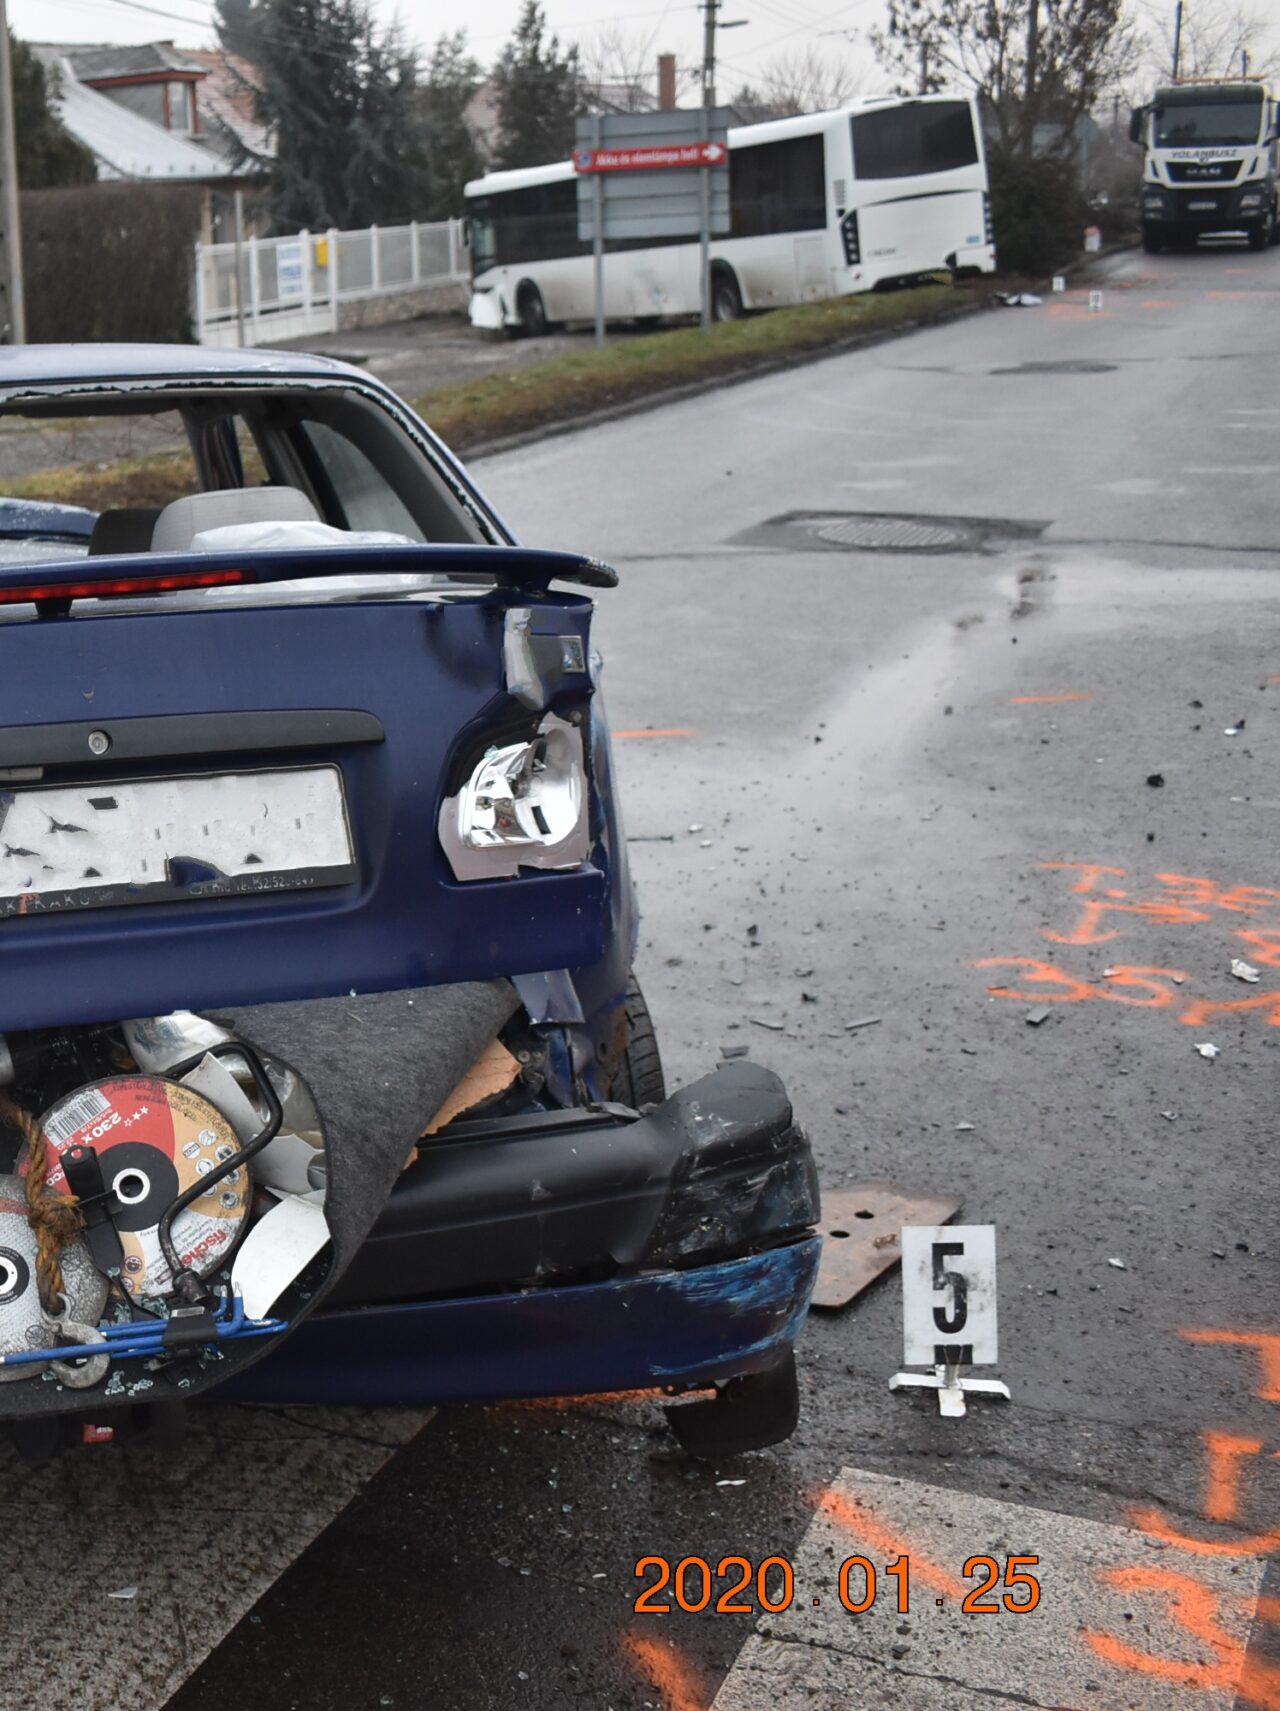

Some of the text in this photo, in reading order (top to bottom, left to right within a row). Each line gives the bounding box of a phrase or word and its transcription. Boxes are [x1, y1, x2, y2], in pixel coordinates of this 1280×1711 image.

[92, 1112, 122, 1138] 230
[180, 1228, 228, 1266] fische
[931, 1242, 968, 1334] 5
